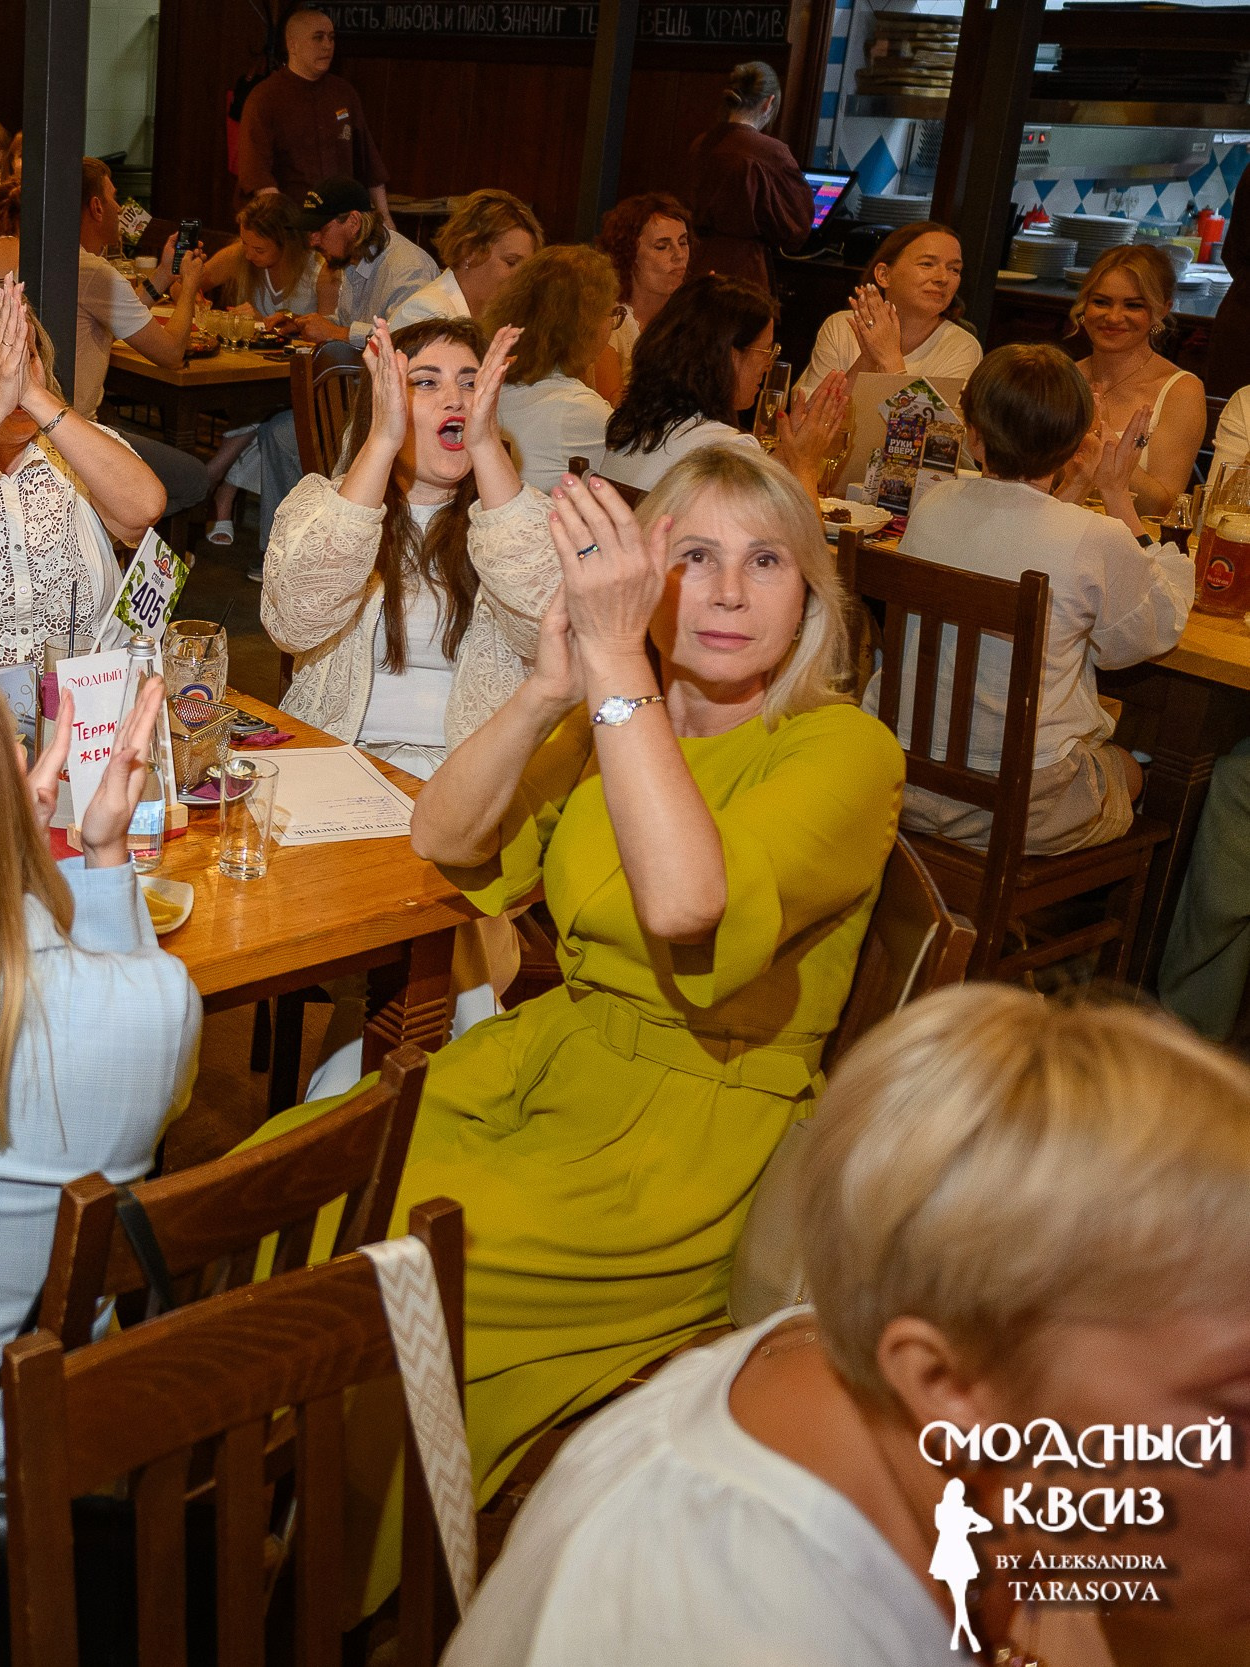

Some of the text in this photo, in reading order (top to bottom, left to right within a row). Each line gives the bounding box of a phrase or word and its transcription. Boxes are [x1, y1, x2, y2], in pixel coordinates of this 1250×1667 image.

[500, 5, 567, 34] ЗНАЧИТ
[640, 8, 692, 37] ВЕШЬ
[704, 8, 787, 40] КРАСИВ
[890, 438, 913, 449] РУКИ
[130, 580, 166, 629] 405
[66, 668, 123, 689] МОДНЫЙ
[72, 720, 118, 741] ТЕРРИ
[80, 746, 111, 764] ЖЕН
